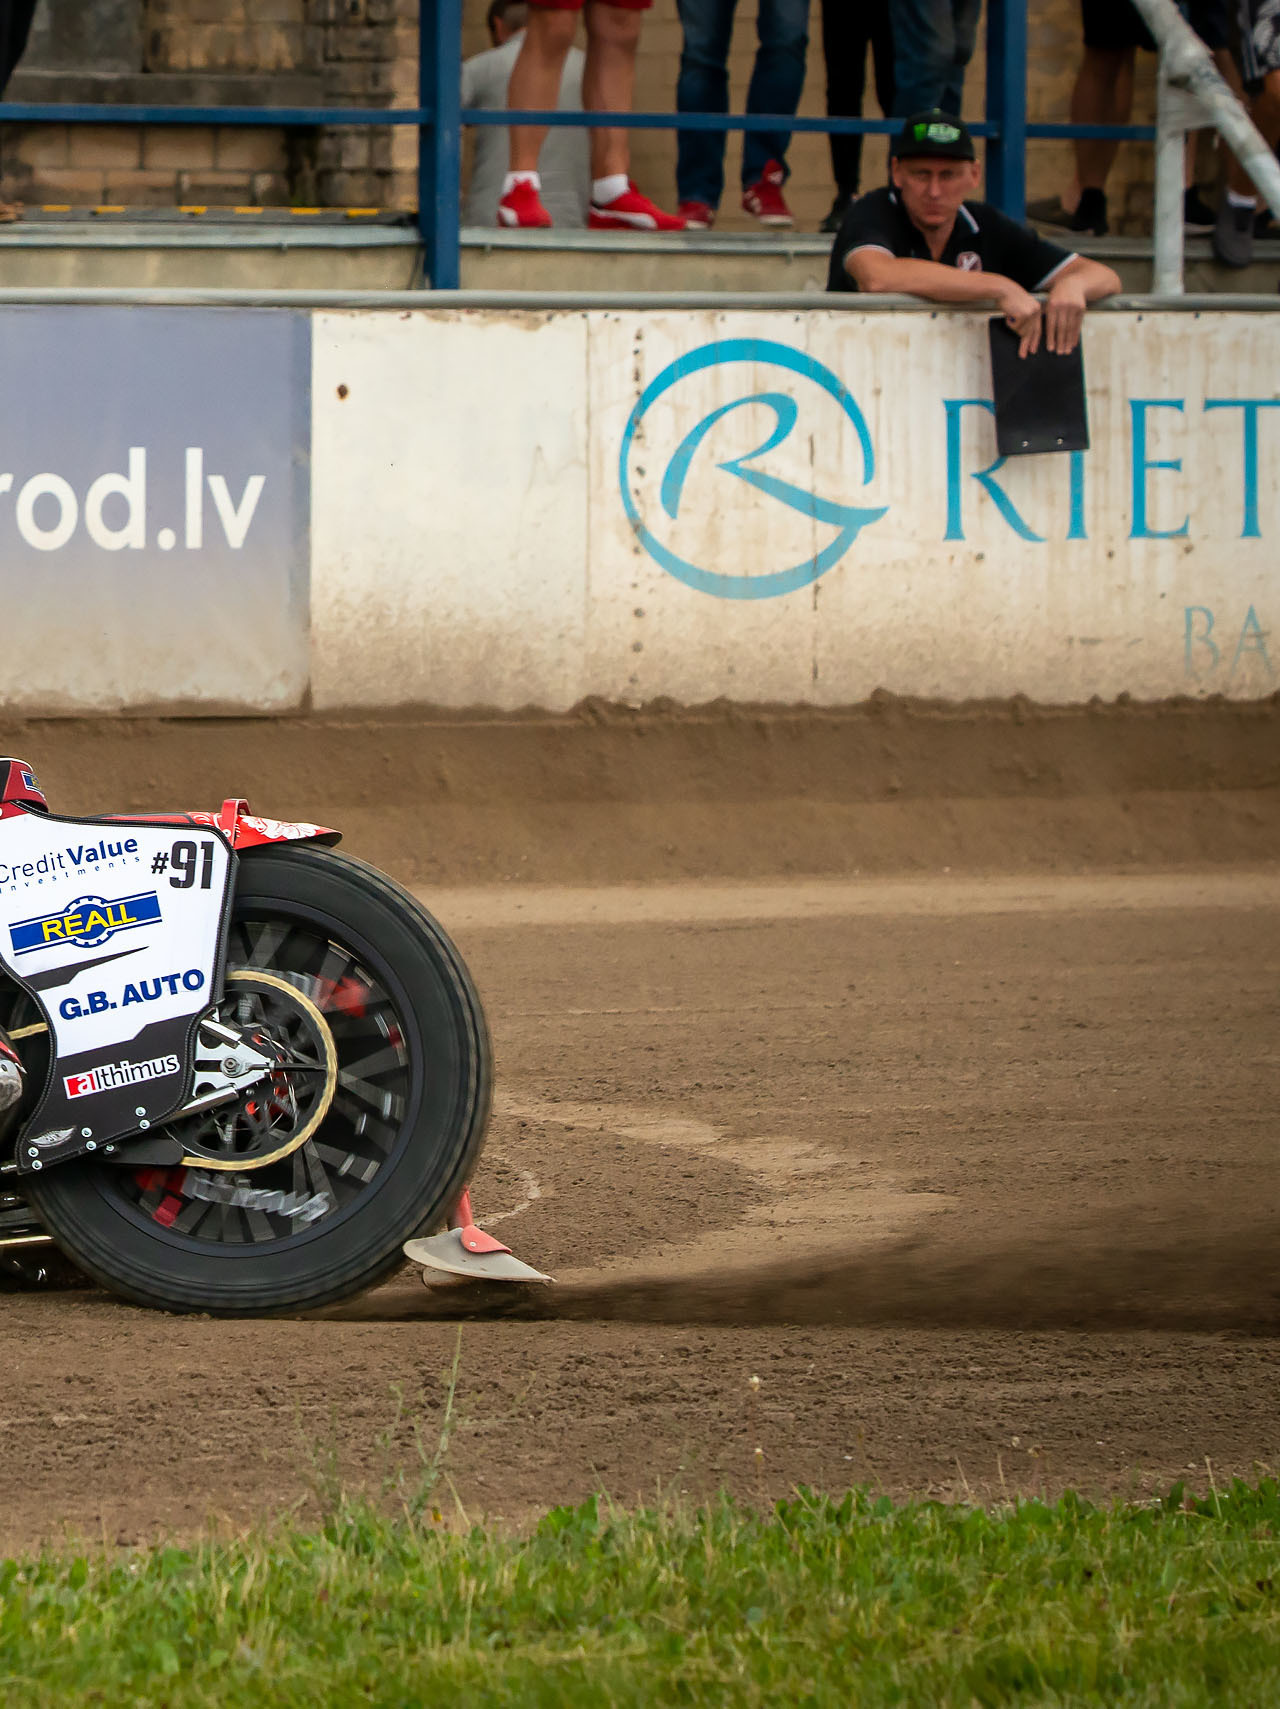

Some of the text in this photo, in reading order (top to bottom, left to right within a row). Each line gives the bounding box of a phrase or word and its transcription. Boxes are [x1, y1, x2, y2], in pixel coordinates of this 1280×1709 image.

[150, 840, 214, 890] #91
[41, 904, 138, 942] REALL
[59, 968, 205, 1020] G.B. AUTO
[66, 1054, 179, 1097] althimus
